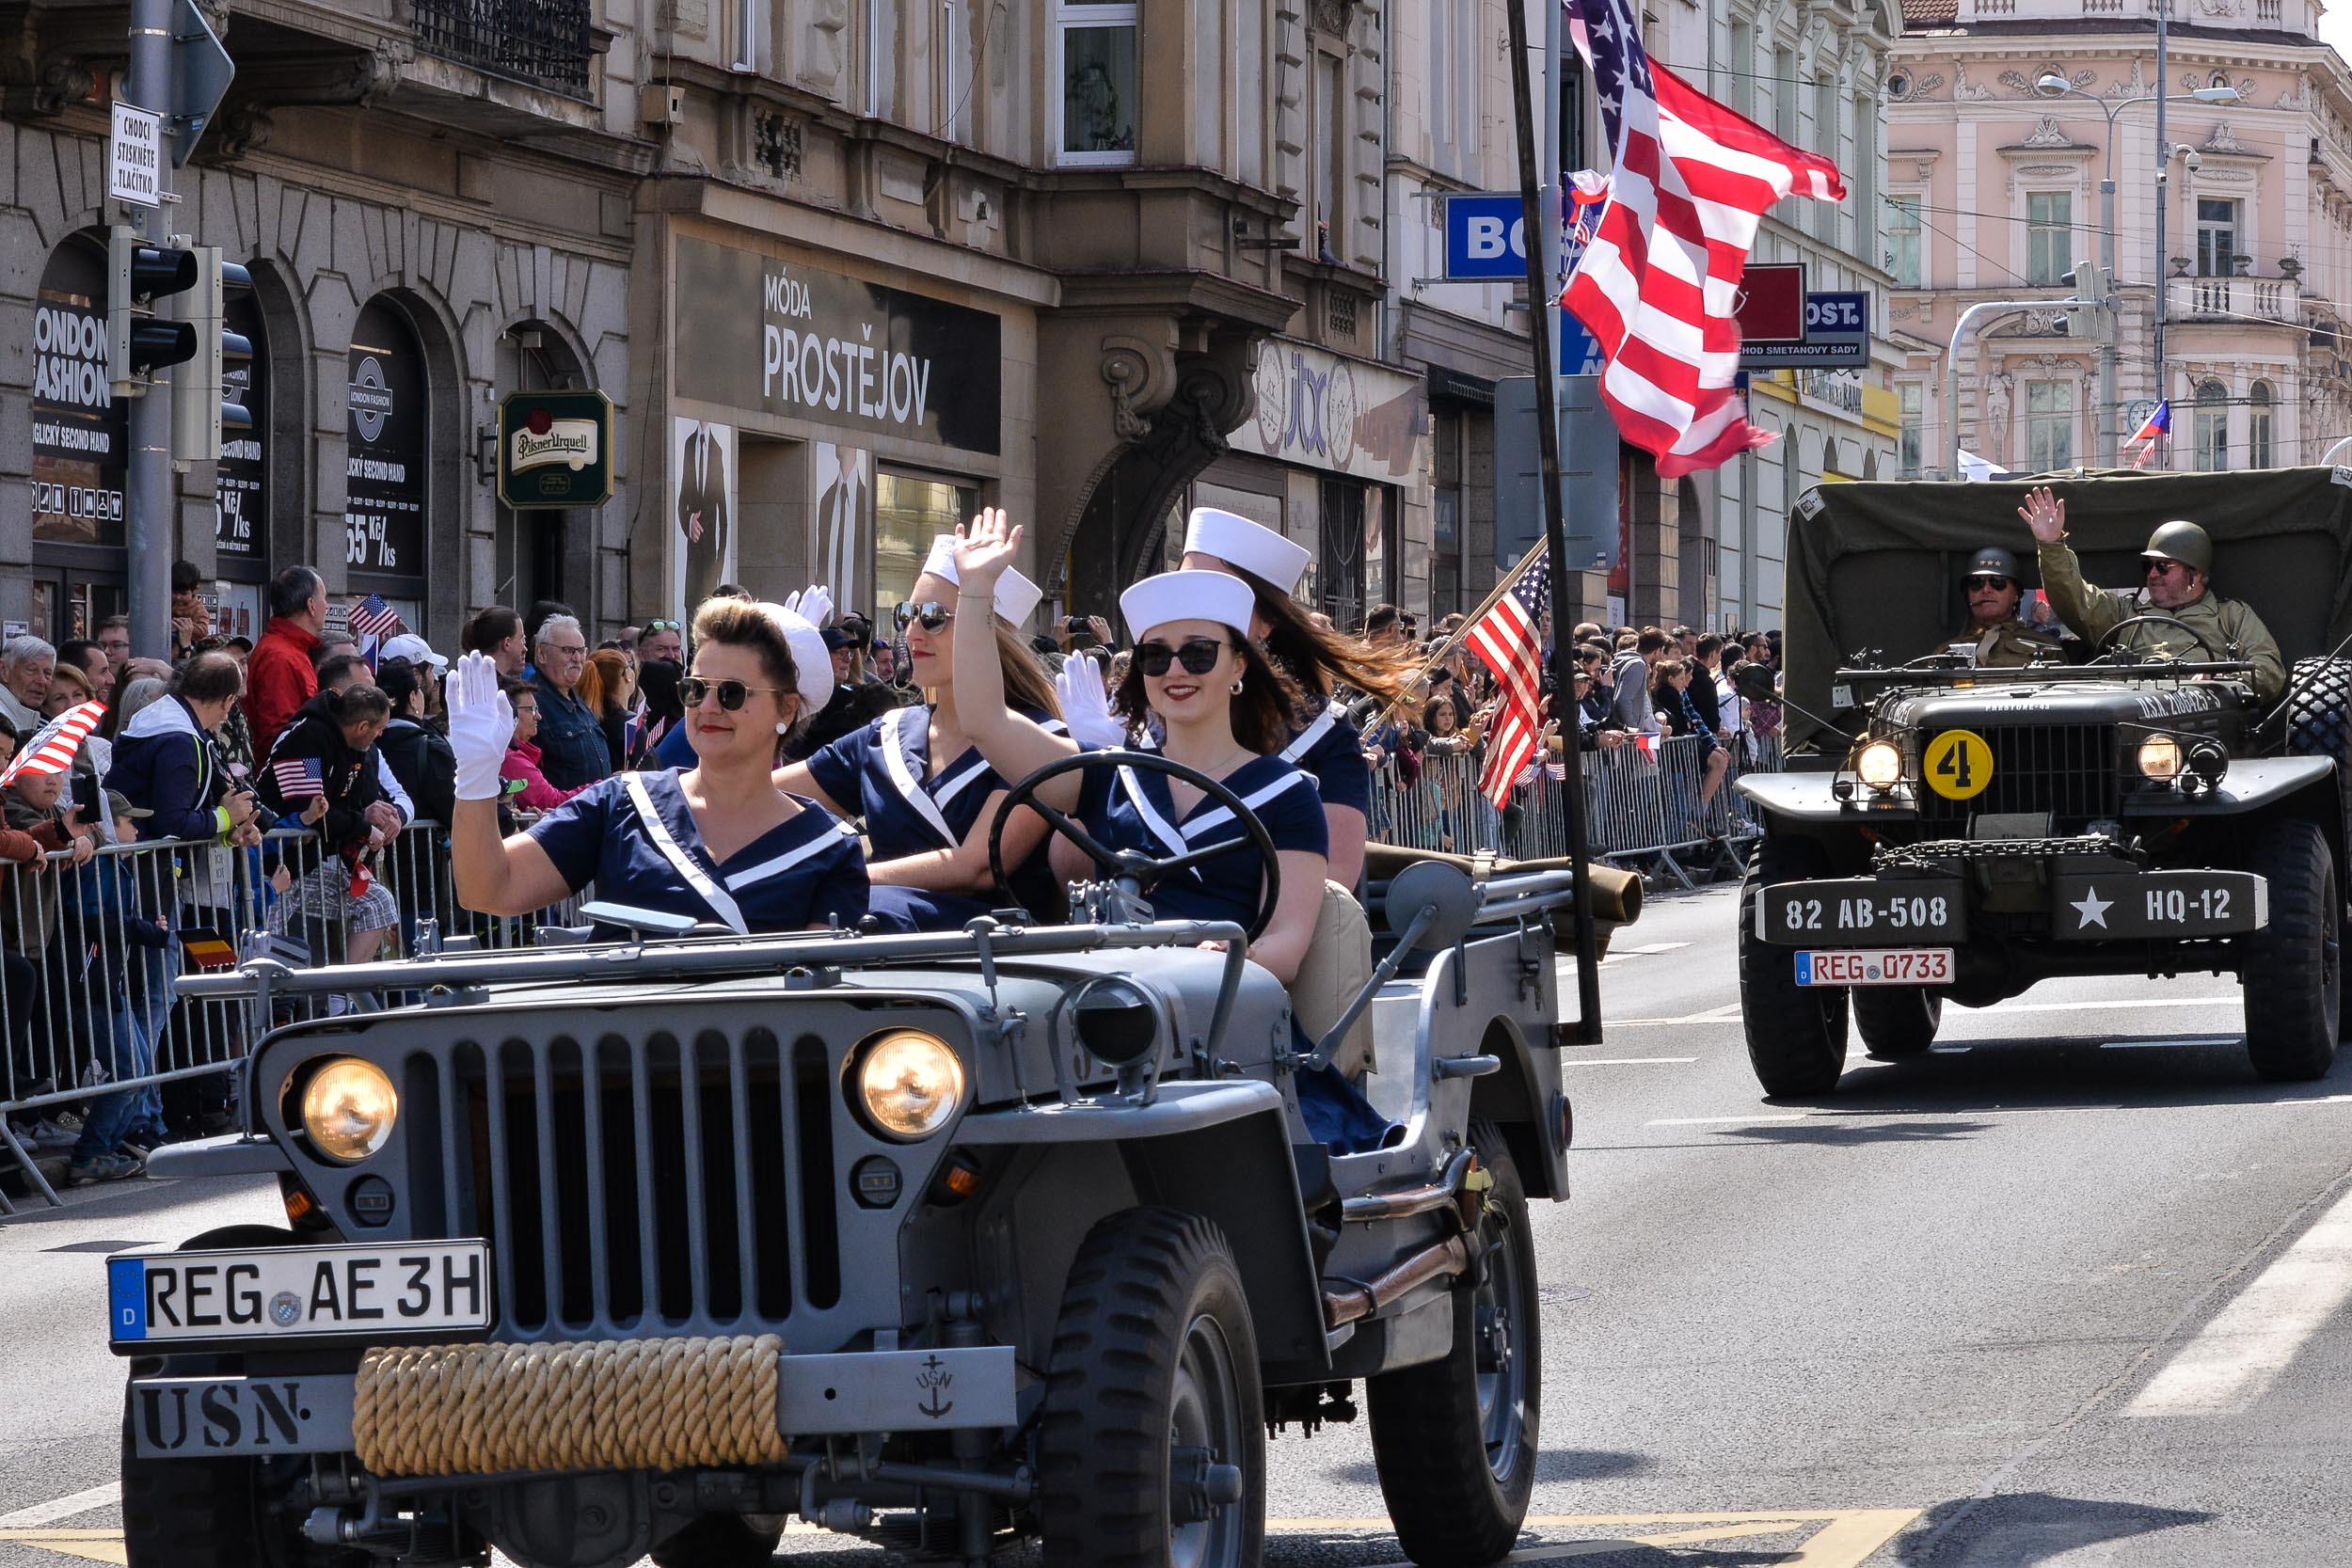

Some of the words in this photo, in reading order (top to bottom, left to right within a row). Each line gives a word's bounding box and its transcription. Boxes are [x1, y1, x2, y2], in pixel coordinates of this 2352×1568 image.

[123, 117, 151, 140] CHODCI
[118, 142, 154, 168] STISKNĚTE
[119, 168, 152, 195] TLAČÍTKO
[765, 267, 812, 320] MÓDA
[34, 307, 109, 361] ONDON
[1766, 346, 1828, 356] SMETANOVY
[1831, 345, 1857, 355] SADY
[34, 355, 111, 408] ASHION
[764, 323, 930, 426] PROSTĚJOV
[351, 390, 371, 404] LONDON
[371, 394, 389, 408] FASHION
[61, 426, 89, 451] SECOND
[90, 431, 110, 453] HAND
[245, 440, 262, 461] HAND
[517, 434, 552, 460] Pilsner
[551, 433, 587, 454] Urquell
[346, 453, 363, 478] ICKÝ
[364, 459, 388, 481] SECOND
[389, 462, 405, 483] HAND
[1936, 740, 1972, 787] 4
[1786, 900, 1822, 929] 82
[1838, 897, 1947, 928] AB-508
[2147, 889, 2231, 923] HQ-12
[1814, 956, 1864, 980] REG
[1883, 954, 1947, 979] 0733
[123, 1307, 136, 1325] D
[145, 1263, 262, 1327] REG
[915, 1370, 952, 1389] USN
[139, 1383, 300, 1449] USN
